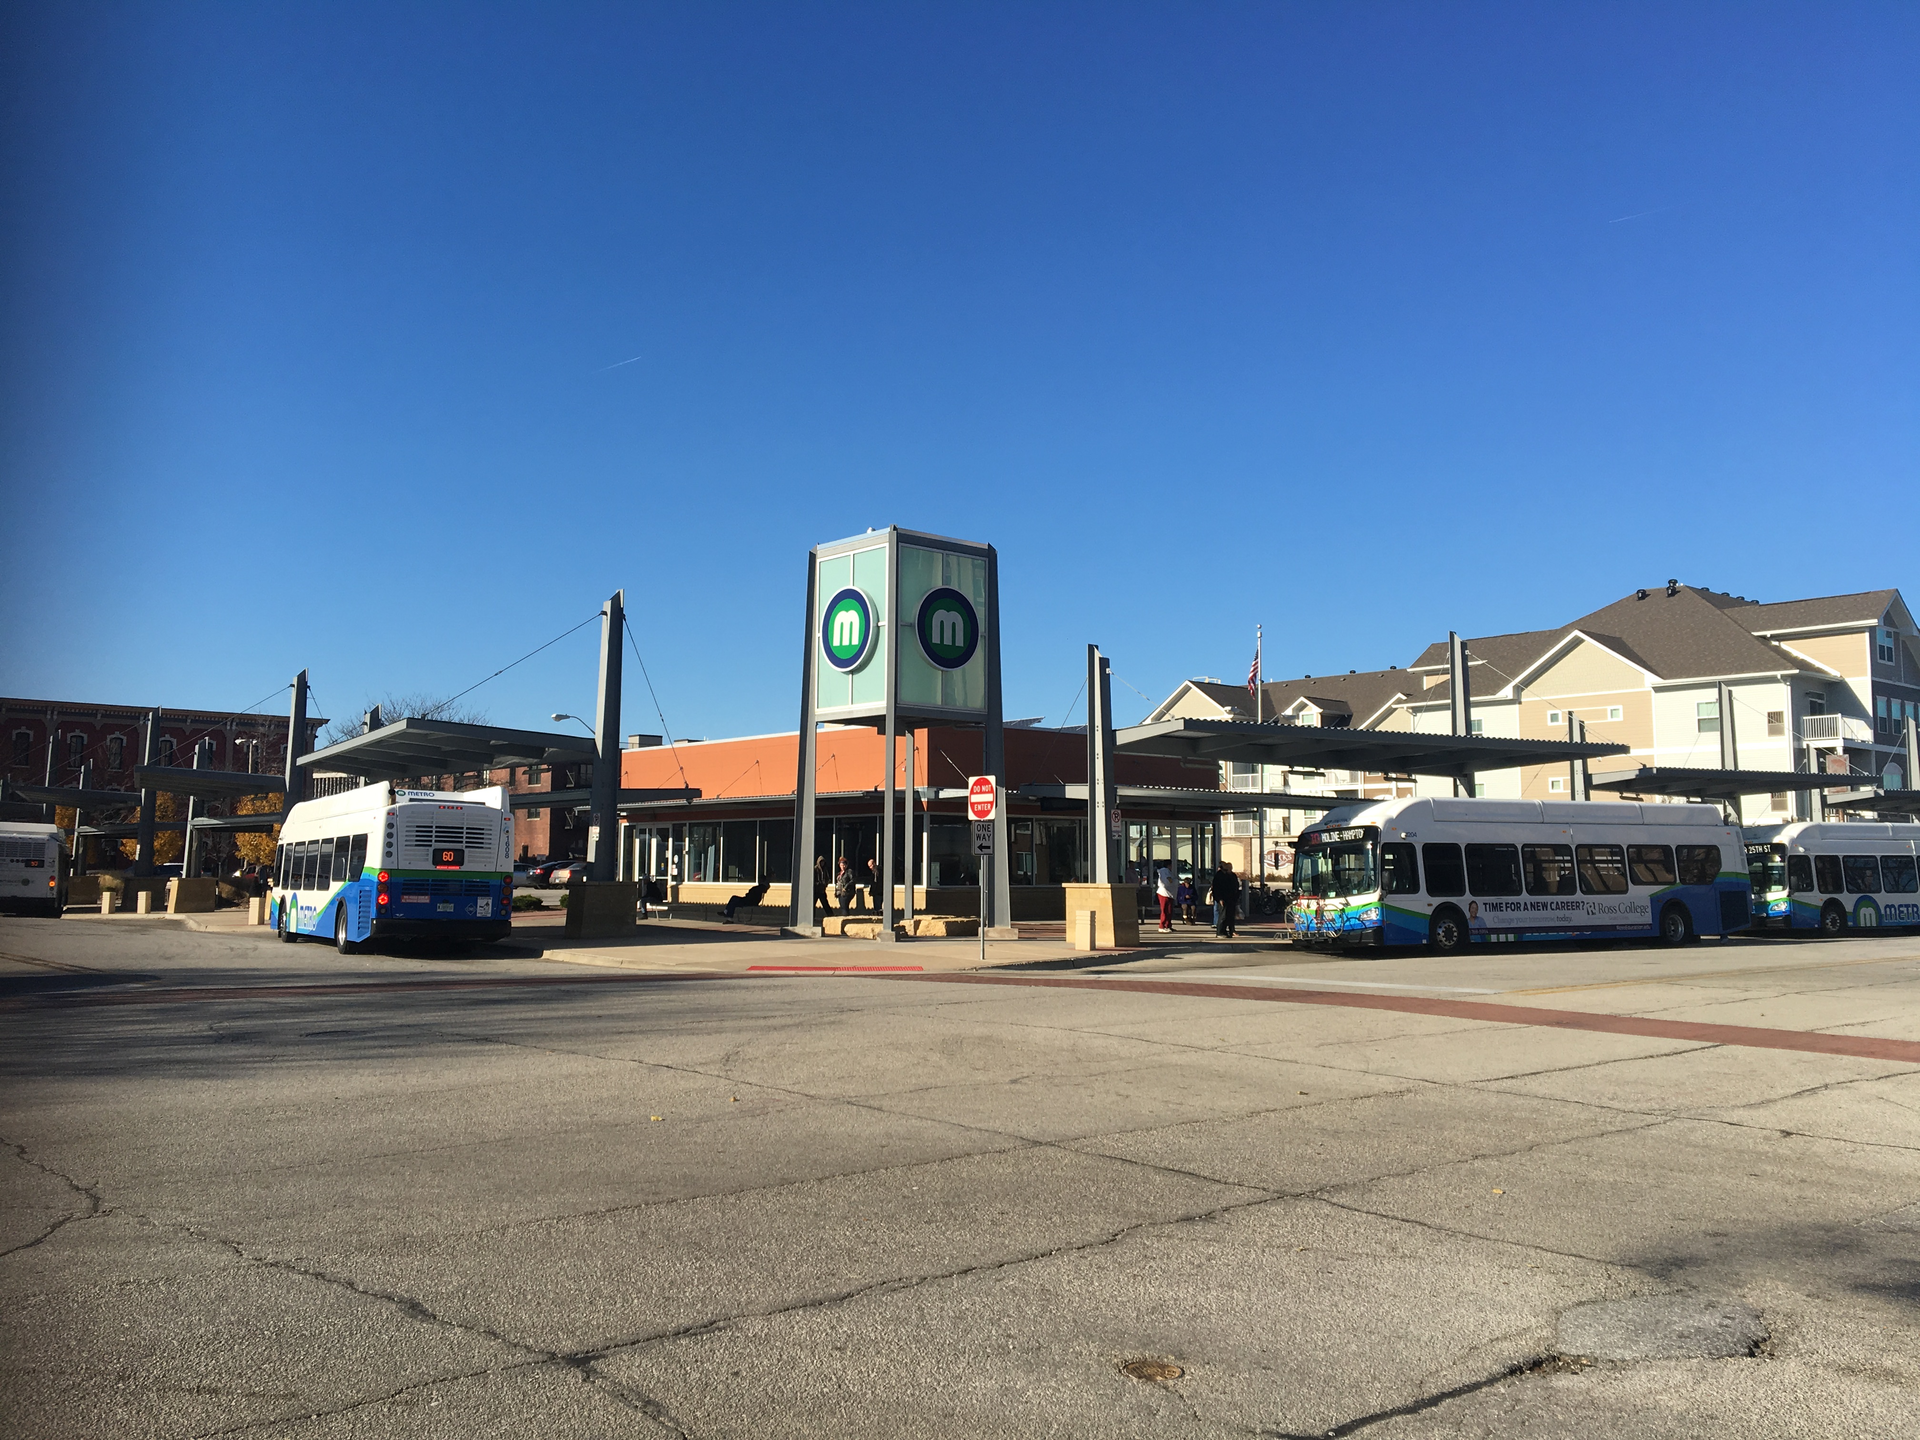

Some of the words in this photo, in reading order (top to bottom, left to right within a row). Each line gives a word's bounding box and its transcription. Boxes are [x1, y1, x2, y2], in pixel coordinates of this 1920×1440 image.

[973, 785, 980, 793] DO
[976, 824, 991, 832] ONE
[1748, 845, 1763, 854] 25TH
[1763, 844, 1771, 853] ST
[442, 851, 454, 861] 60
[1483, 902, 1504, 913] TIME
[1505, 902, 1521, 912] FOR
[1523, 901, 1530, 912] A
[1530, 901, 1548, 911] NEW
[1550, 901, 1585, 911] CAREER?
[1598, 903, 1618, 914] Ross
[1618, 901, 1649, 916] College
